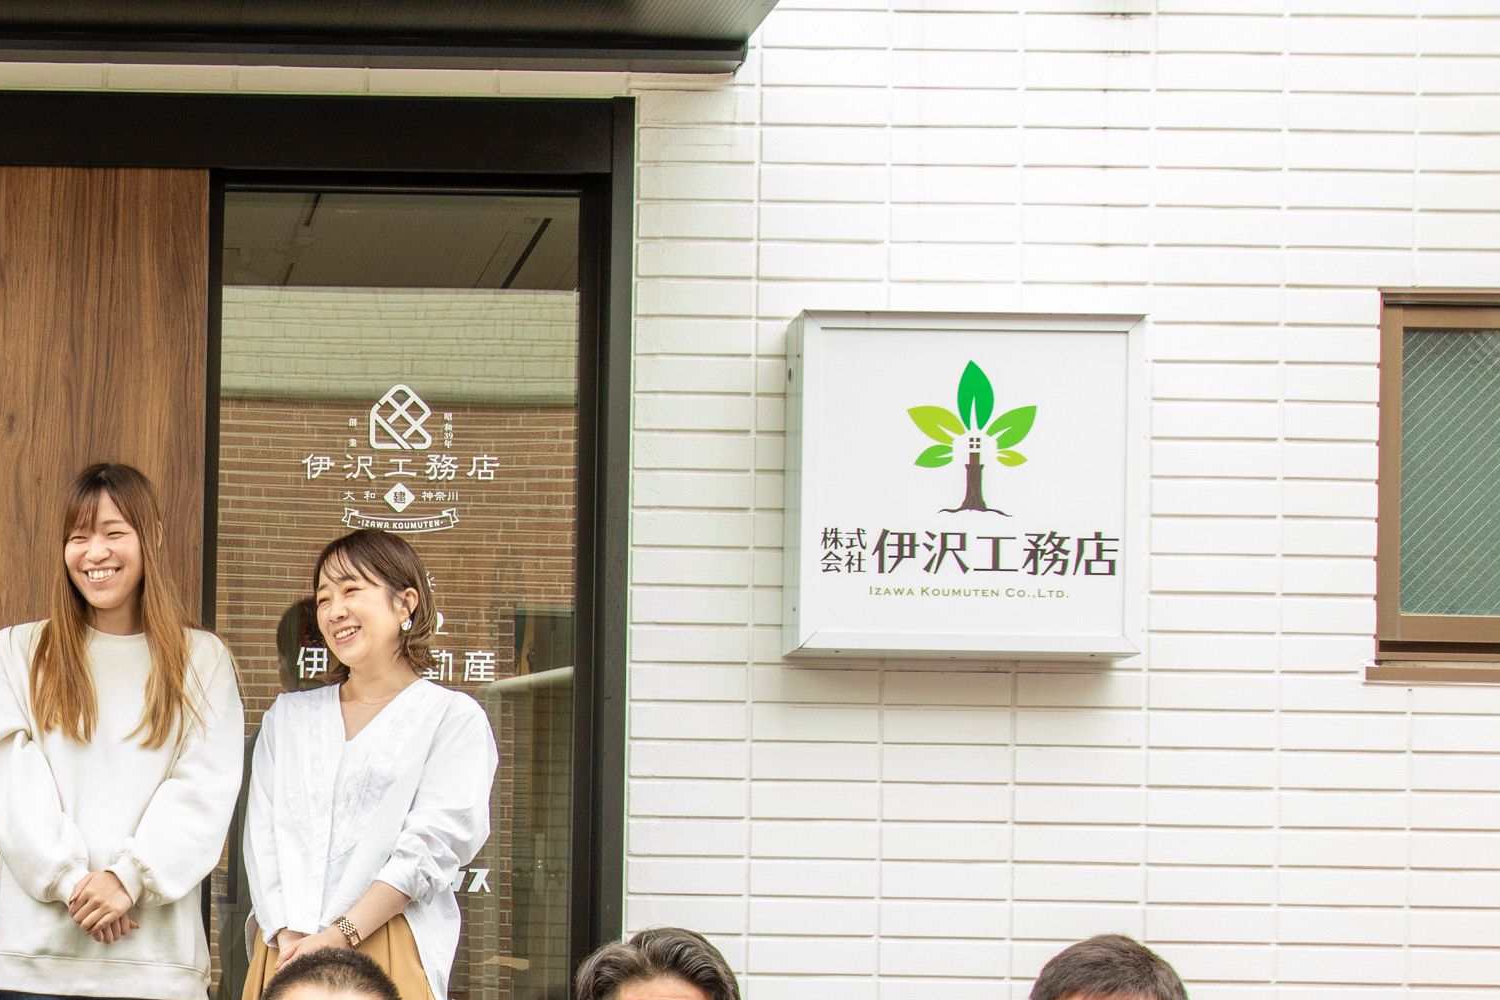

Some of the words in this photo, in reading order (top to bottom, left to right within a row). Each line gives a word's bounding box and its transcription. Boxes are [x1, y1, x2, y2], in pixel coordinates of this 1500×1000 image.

[302, 453, 500, 481] 伊沢工務店
[343, 490, 376, 501] 大和
[421, 490, 459, 501] 神奈川
[361, 519, 390, 529] IZAWA
[392, 519, 441, 529] KOUMUTEN
[821, 527, 867, 550] 株式
[821, 551, 867, 573] 会社
[872, 528, 1120, 576] 伊沢工務店
[297, 646, 496, 682] 伊動産
